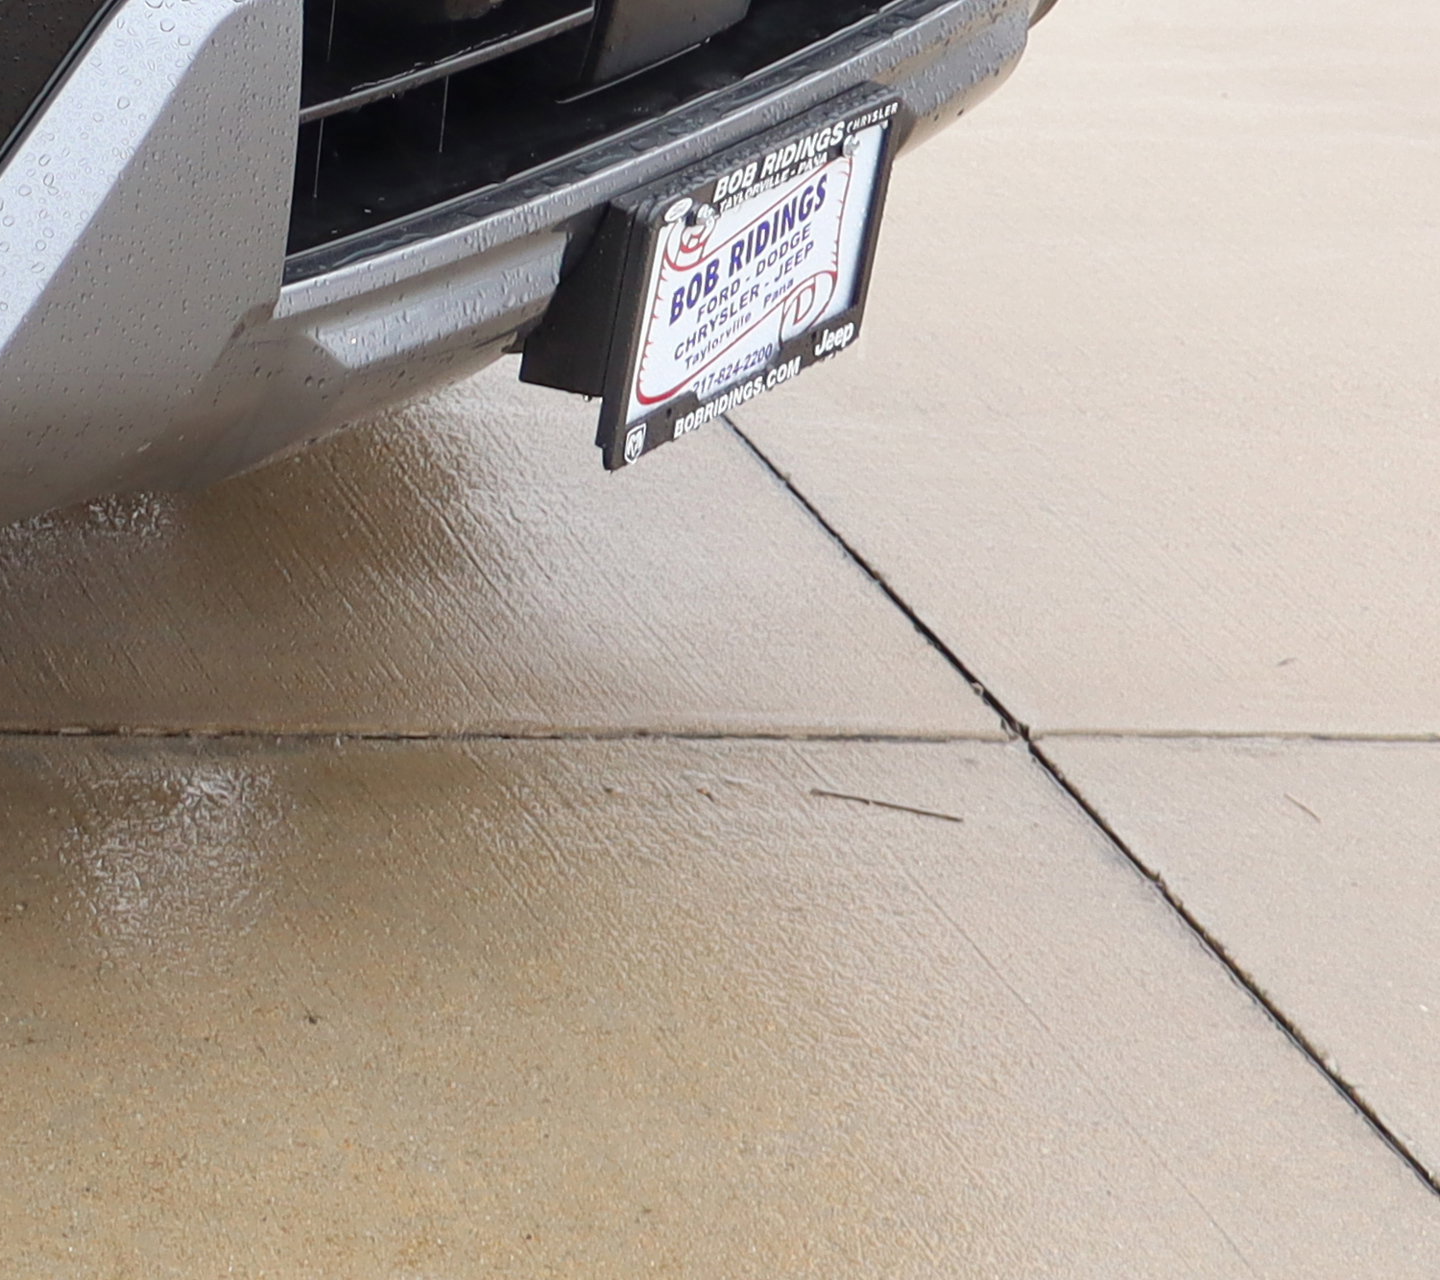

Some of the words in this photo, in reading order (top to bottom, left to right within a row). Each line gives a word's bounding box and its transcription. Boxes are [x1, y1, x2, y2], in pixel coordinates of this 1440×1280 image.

[846, 101, 899, 134] CHRYSLER
[712, 161, 757, 204] BOB
[760, 121, 846, 181] RIDINGS
[719, 168, 790, 214] TAYLORVILLE
[669, 257, 720, 326] BOB
[728, 173, 829, 278] RIDINGS
[697, 279, 741, 324] FORD
[756, 222, 812, 278] DODGE
[674, 283, 760, 361] CHRYSLER
[774, 240, 814, 282] JEEP
[685, 311, 752, 370] Taylorville
[763, 277, 794, 310] Pana
[814, 322, 855, 357] Jeep
[673, 356, 802, 439] BOBRIDINGS.COM
